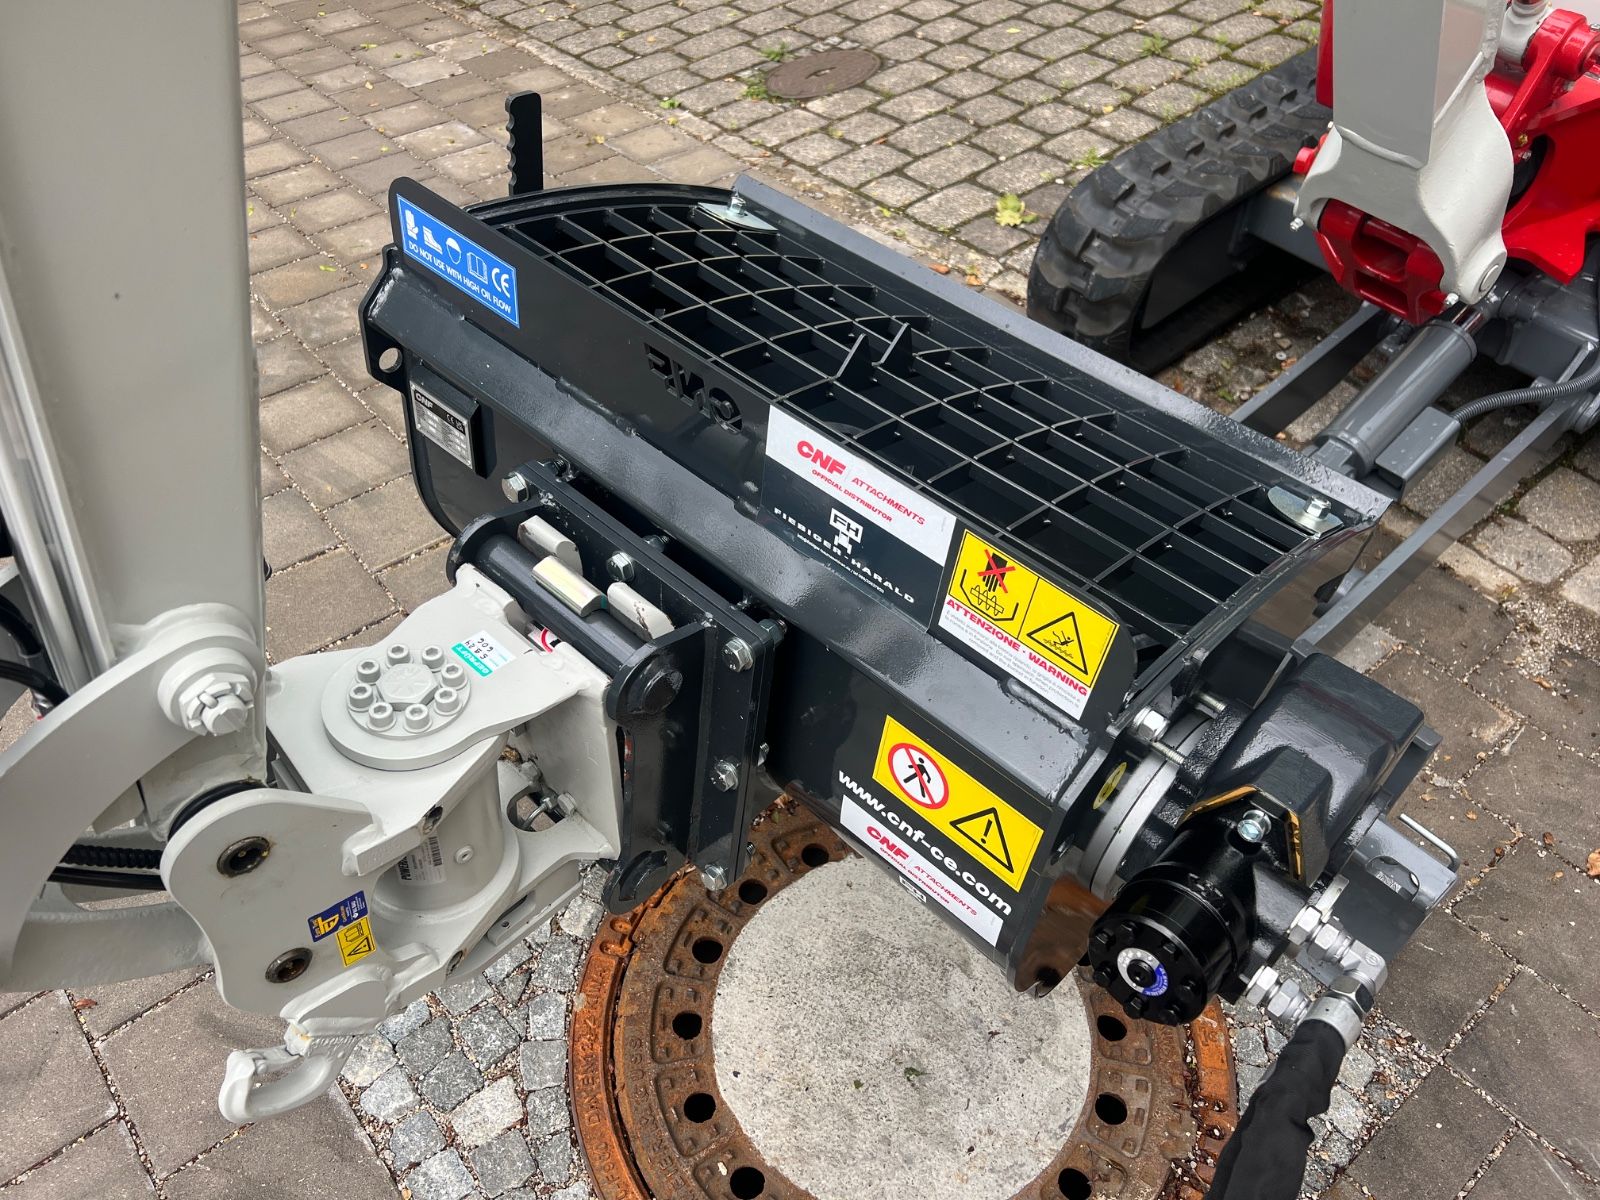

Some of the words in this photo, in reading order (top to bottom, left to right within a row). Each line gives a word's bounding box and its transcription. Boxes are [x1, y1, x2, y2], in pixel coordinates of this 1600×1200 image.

[408, 240, 419, 253] DO
[419, 246, 433, 263] NOT
[433, 256, 446, 271] USE
[445, 263, 463, 282] WITH
[462, 273, 480, 293] HIGH
[480, 287, 492, 301] OIL
[492, 295, 512, 314] FLOW
[796, 440, 847, 476] CNF
[851, 477, 926, 526] ATTACHMENTS
[811, 468, 843, 492] OFFICIAL
[843, 489, 893, 523] DISTRIBUTOR
[946, 599, 1021, 652] ATTENZIONE
[1028, 652, 1088, 697] WARNING
[838, 770, 1012, 916] www.cnf-ce.com
[866, 825, 910, 862] CNF
[914, 865, 978, 916] ATTACHMENTS
[879, 847, 907, 872] OFFICIAL
[907, 869, 950, 904] DISTRIBUTOR
